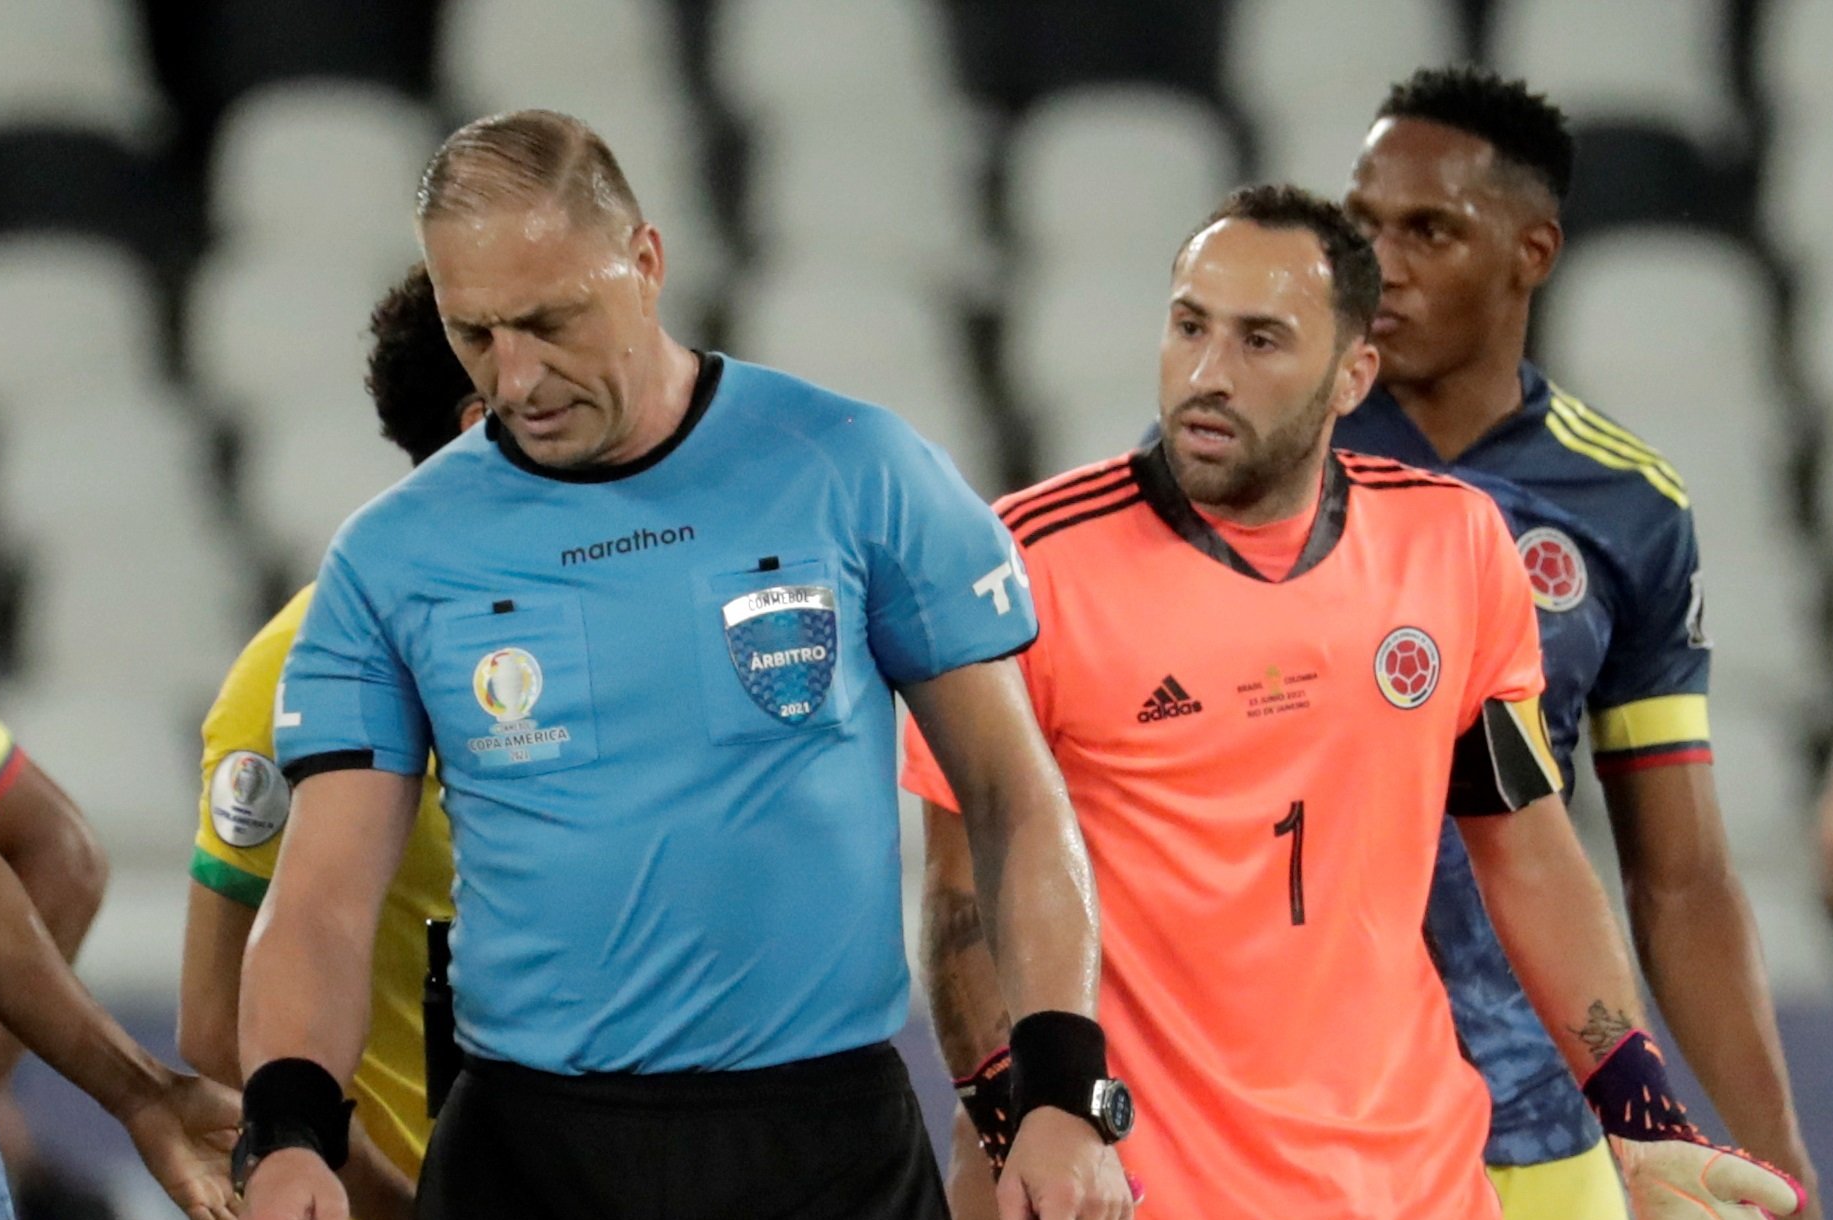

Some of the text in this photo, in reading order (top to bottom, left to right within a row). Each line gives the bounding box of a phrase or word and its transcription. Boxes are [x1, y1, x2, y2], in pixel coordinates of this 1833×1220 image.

[560, 525, 695, 567] marathon
[748, 590, 810, 612] CONMEBOL
[750, 645, 827, 671] ÁRBITRO
[780, 702, 811, 716] 2021
[1136, 700, 1203, 724] adidas
[470, 729, 568, 751] COPA AMERICA
[1273, 799, 1306, 926] 1
